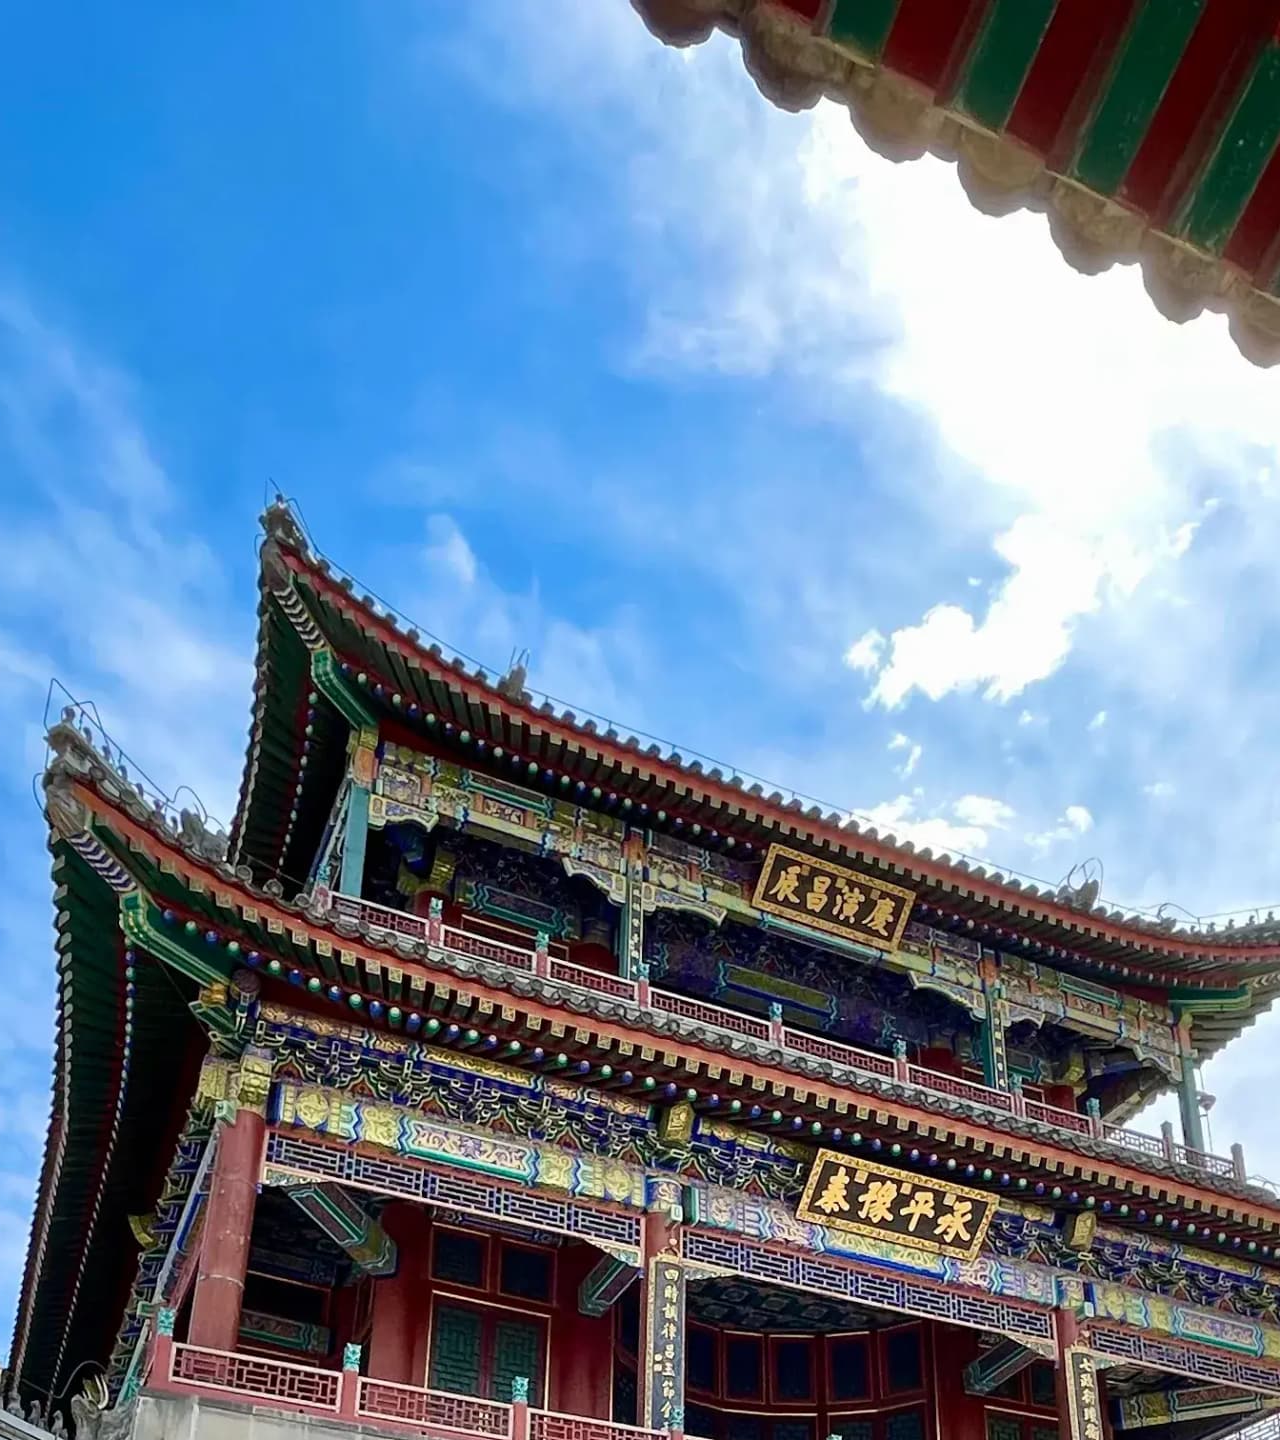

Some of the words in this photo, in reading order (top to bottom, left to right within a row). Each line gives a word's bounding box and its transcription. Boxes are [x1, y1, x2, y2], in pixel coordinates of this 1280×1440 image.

[768, 865, 896, 937] 慶演昌辰
[814, 1167, 973, 1243] 承平豫泰
